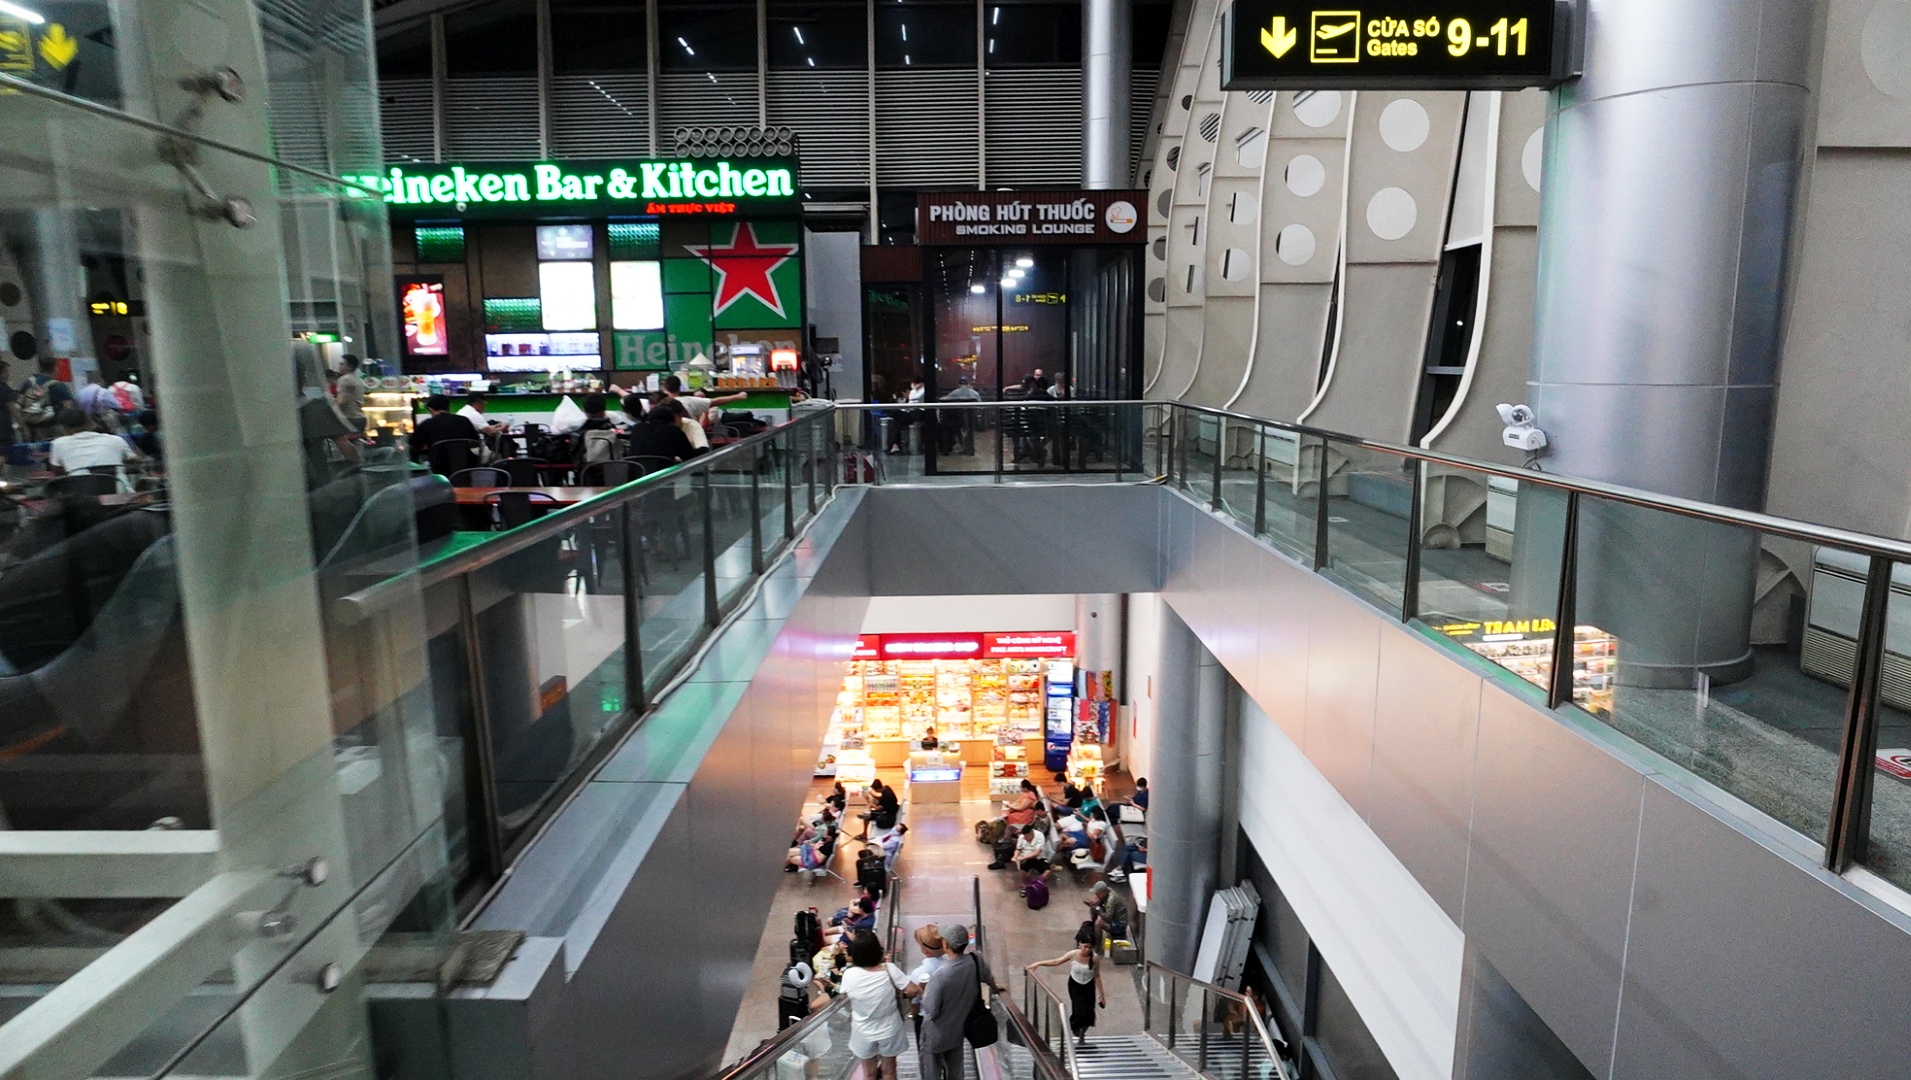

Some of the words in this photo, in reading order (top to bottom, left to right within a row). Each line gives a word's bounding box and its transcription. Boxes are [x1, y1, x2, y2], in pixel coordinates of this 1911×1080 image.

[1366, 38, 1419, 57] Gates
[534, 164, 604, 201] Bar
[606, 167, 638, 199] &
[640, 161, 794, 198] Kitchen
[929, 200, 990, 222] PHÒNG
[996, 200, 1032, 221] HÚT
[1036, 198, 1095, 221] THUỐC
[955, 224, 1027, 235] SMOKING
[1032, 223, 1095, 234] LOUNGE
[619, 332, 799, 367] Heine
